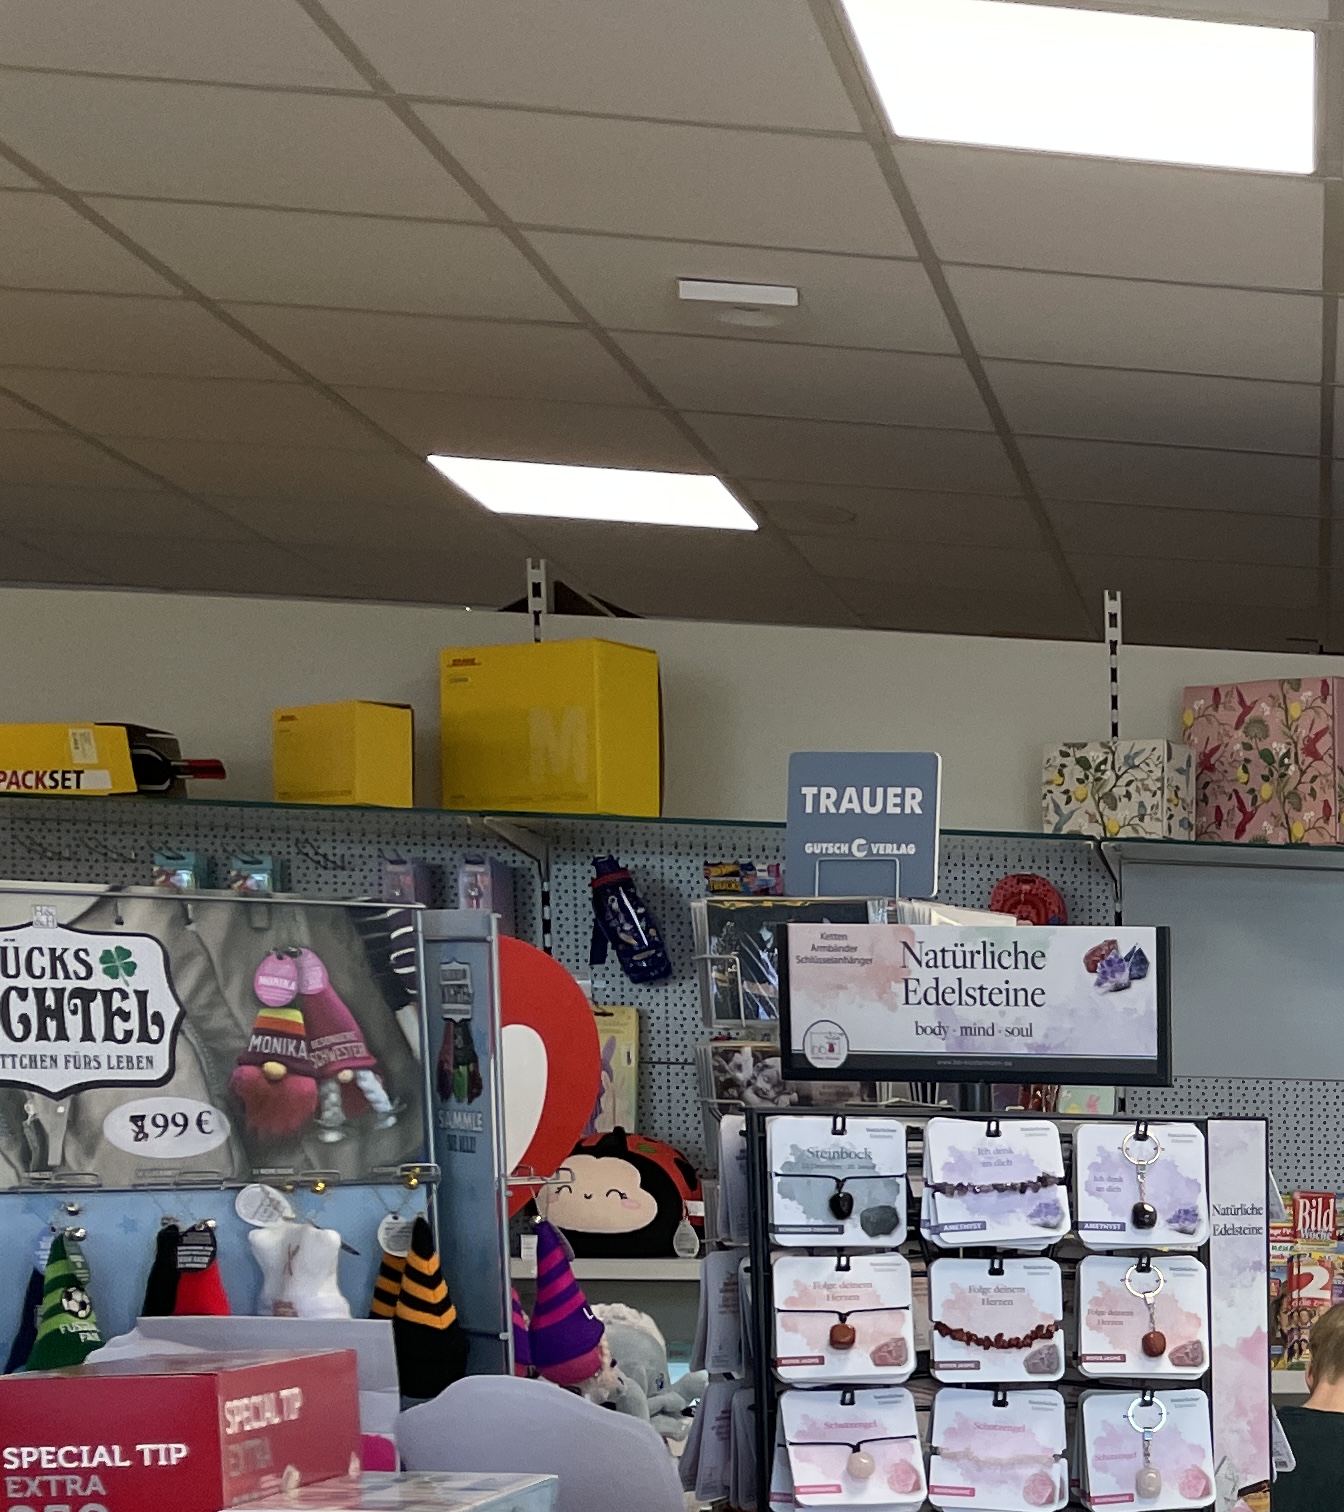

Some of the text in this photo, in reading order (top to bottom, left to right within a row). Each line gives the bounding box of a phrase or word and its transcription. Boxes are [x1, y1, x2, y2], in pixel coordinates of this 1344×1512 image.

[801, 786, 923, 814] TRAUER
[805, 842, 849, 855] GUTSCH
[871, 842, 916, 855] VERLAG
[820, 932, 848, 941] Ketten
[900, 940, 1046, 970] Natürliche
[901, 977, 1046, 1008] Edelsteine
[0, 986, 164, 1044] CHTEL
[915, 1021, 1033, 1040] body mind soul
[248, 1034, 309, 1059] MONIKA
[64, 1051, 101, 1070] FÜRS
[107, 1055, 154, 1070] LEBEN
[807, 1147, 873, 1162] Steinbock
[1212, 1203, 1264, 1218] Natürliche
[1300, 1196, 1335, 1231] Bild
[1212, 1223, 1263, 1238] Edelsteine
[2, 1443, 188, 1470] SPECIAL TIP
[5, 1474, 106, 1498] EXTRA
